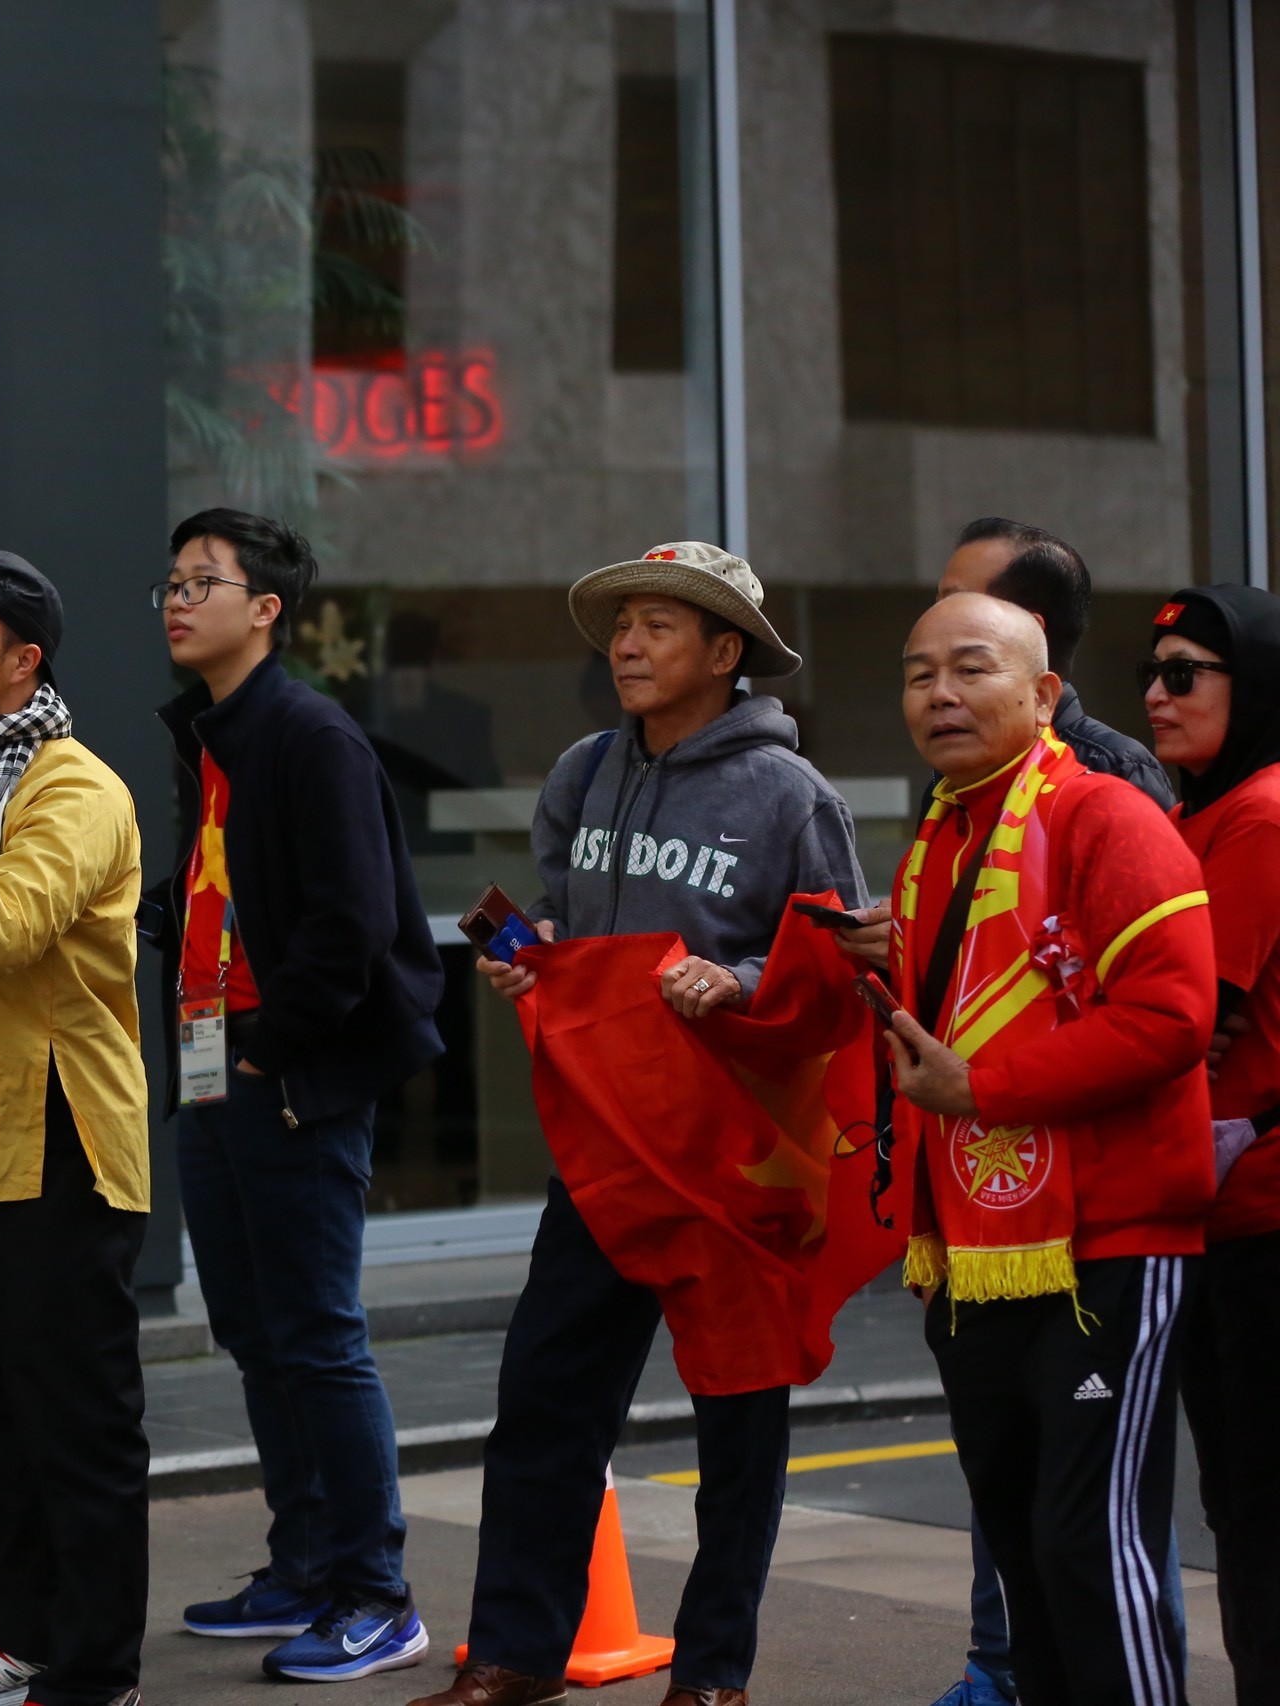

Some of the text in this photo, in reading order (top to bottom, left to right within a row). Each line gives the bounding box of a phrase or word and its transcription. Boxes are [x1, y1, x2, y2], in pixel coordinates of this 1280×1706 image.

[570, 826, 739, 898] UST DO IT.
